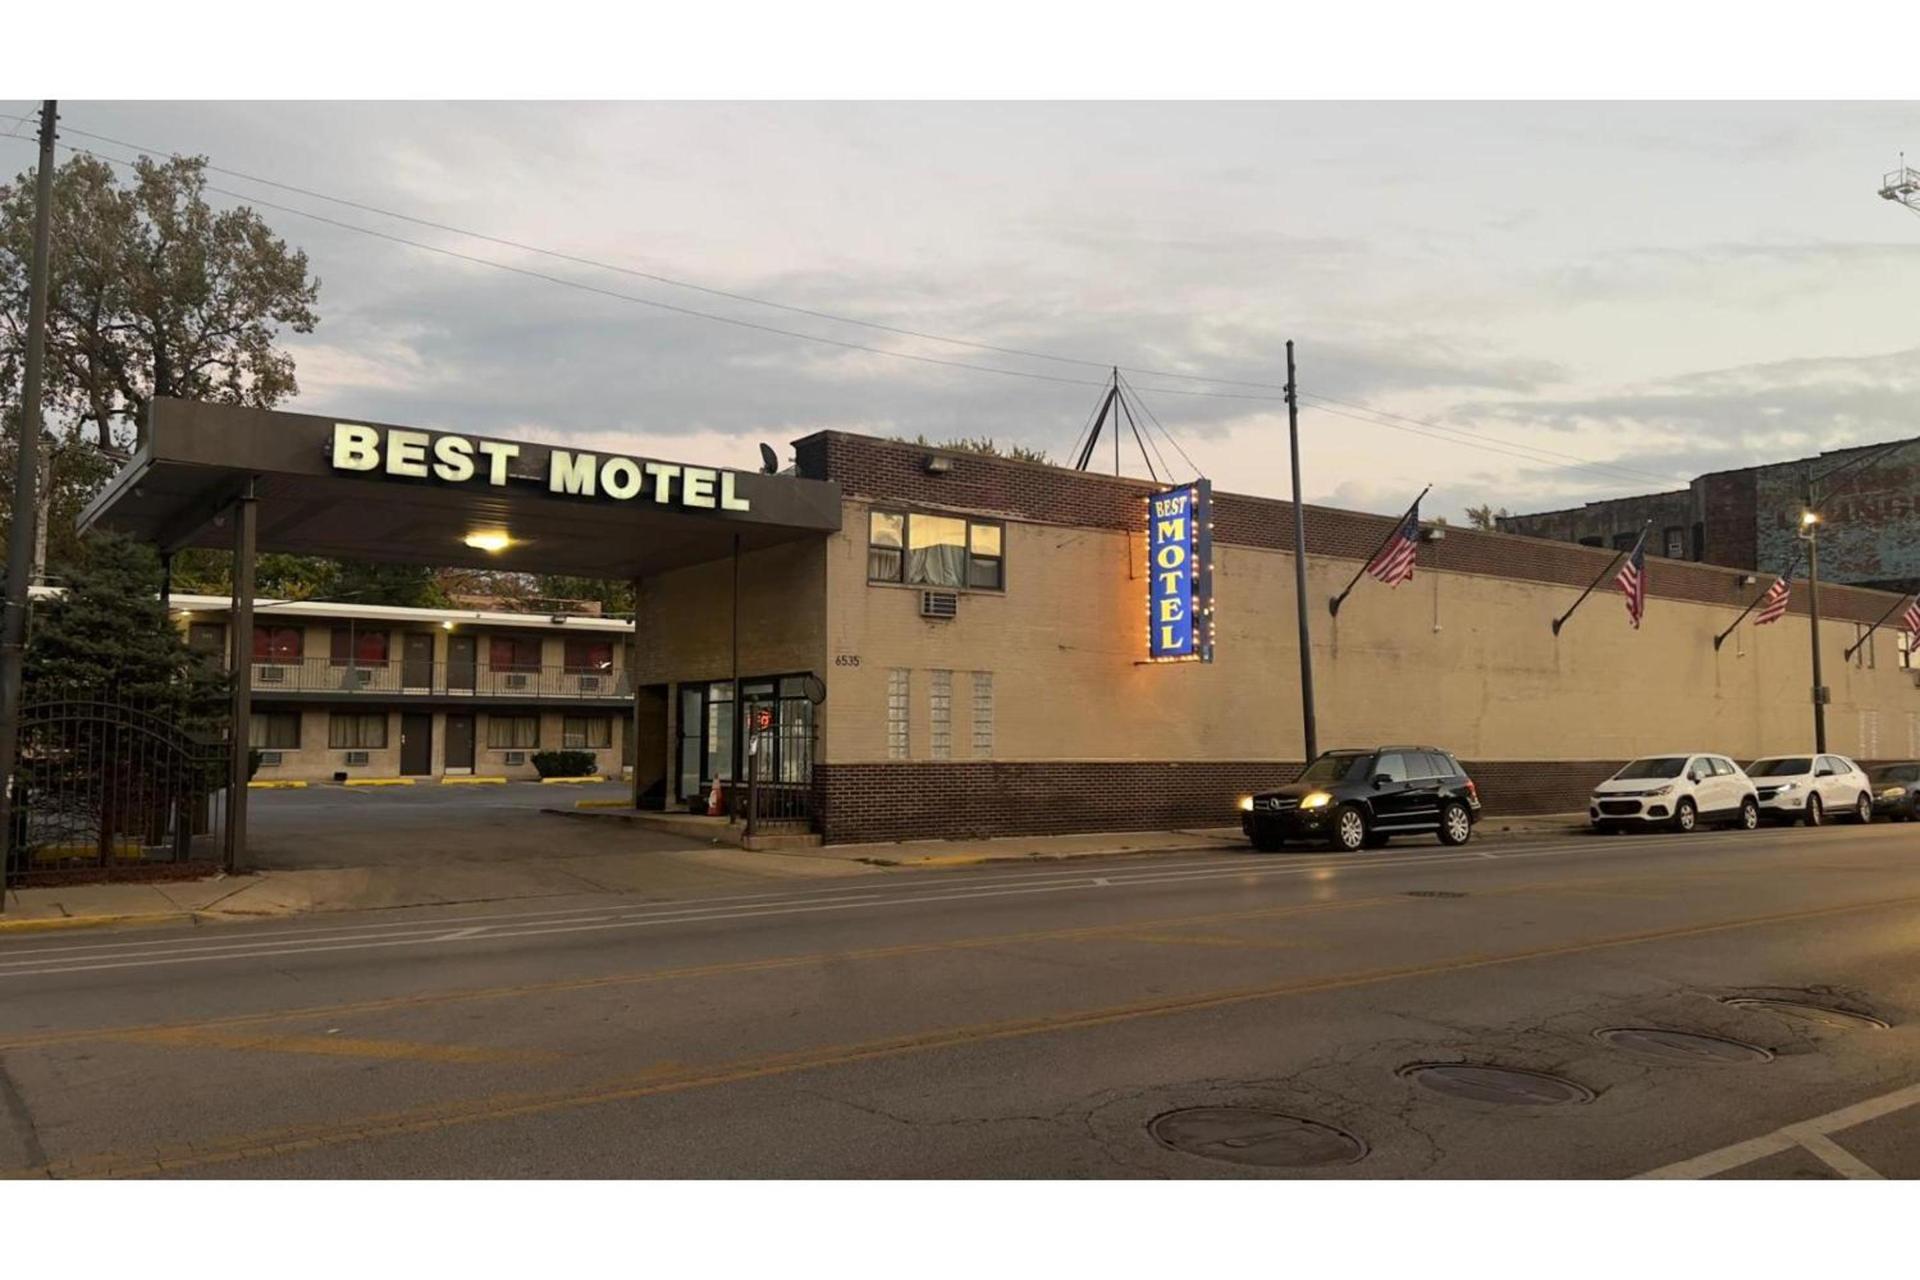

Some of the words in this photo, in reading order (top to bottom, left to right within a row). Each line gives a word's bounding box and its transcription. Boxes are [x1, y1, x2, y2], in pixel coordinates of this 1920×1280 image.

[332, 423, 519, 486] BEST
[549, 450, 750, 511] MOTEL
[1155, 496, 1187, 518] BEST
[1157, 518, 1185, 649] MOTEL
[835, 655, 861, 667] 6535
